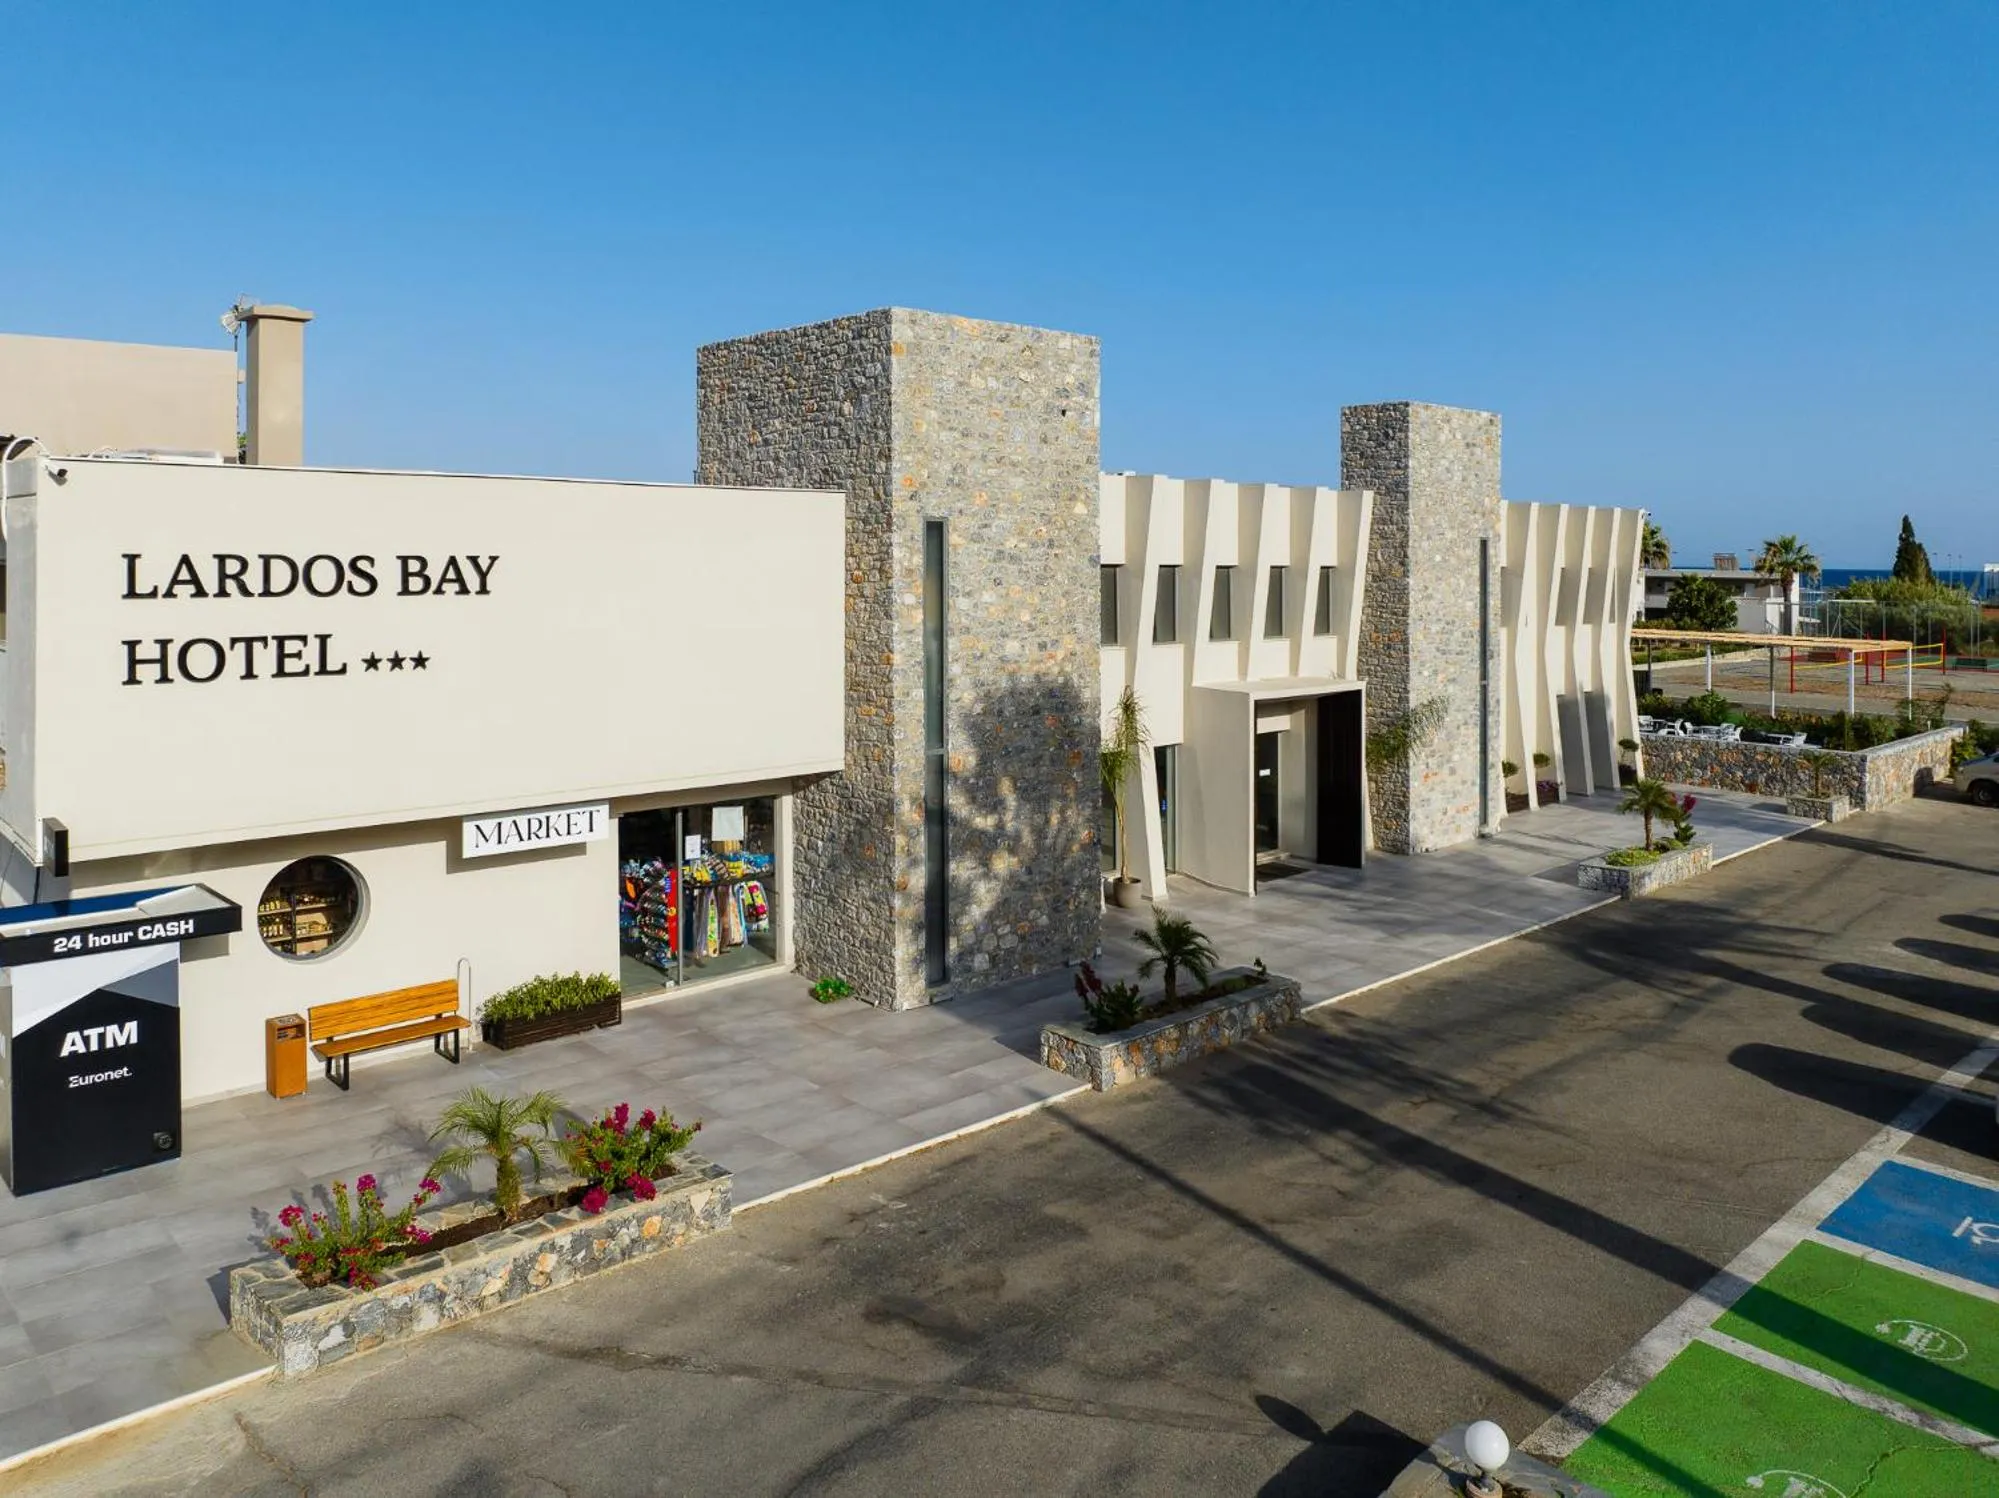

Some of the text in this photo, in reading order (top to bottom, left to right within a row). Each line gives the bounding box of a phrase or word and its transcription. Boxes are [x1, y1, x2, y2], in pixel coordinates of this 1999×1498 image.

[122, 553, 500, 600] LARDOS BAY
[121, 633, 348, 686] HOTEL
[474, 809, 601, 848] MARKET
[53, 918, 195, 953] 24 hour CASH
[59, 1020, 138, 1057] ATM
[68, 1066, 133, 1089] Euronet
